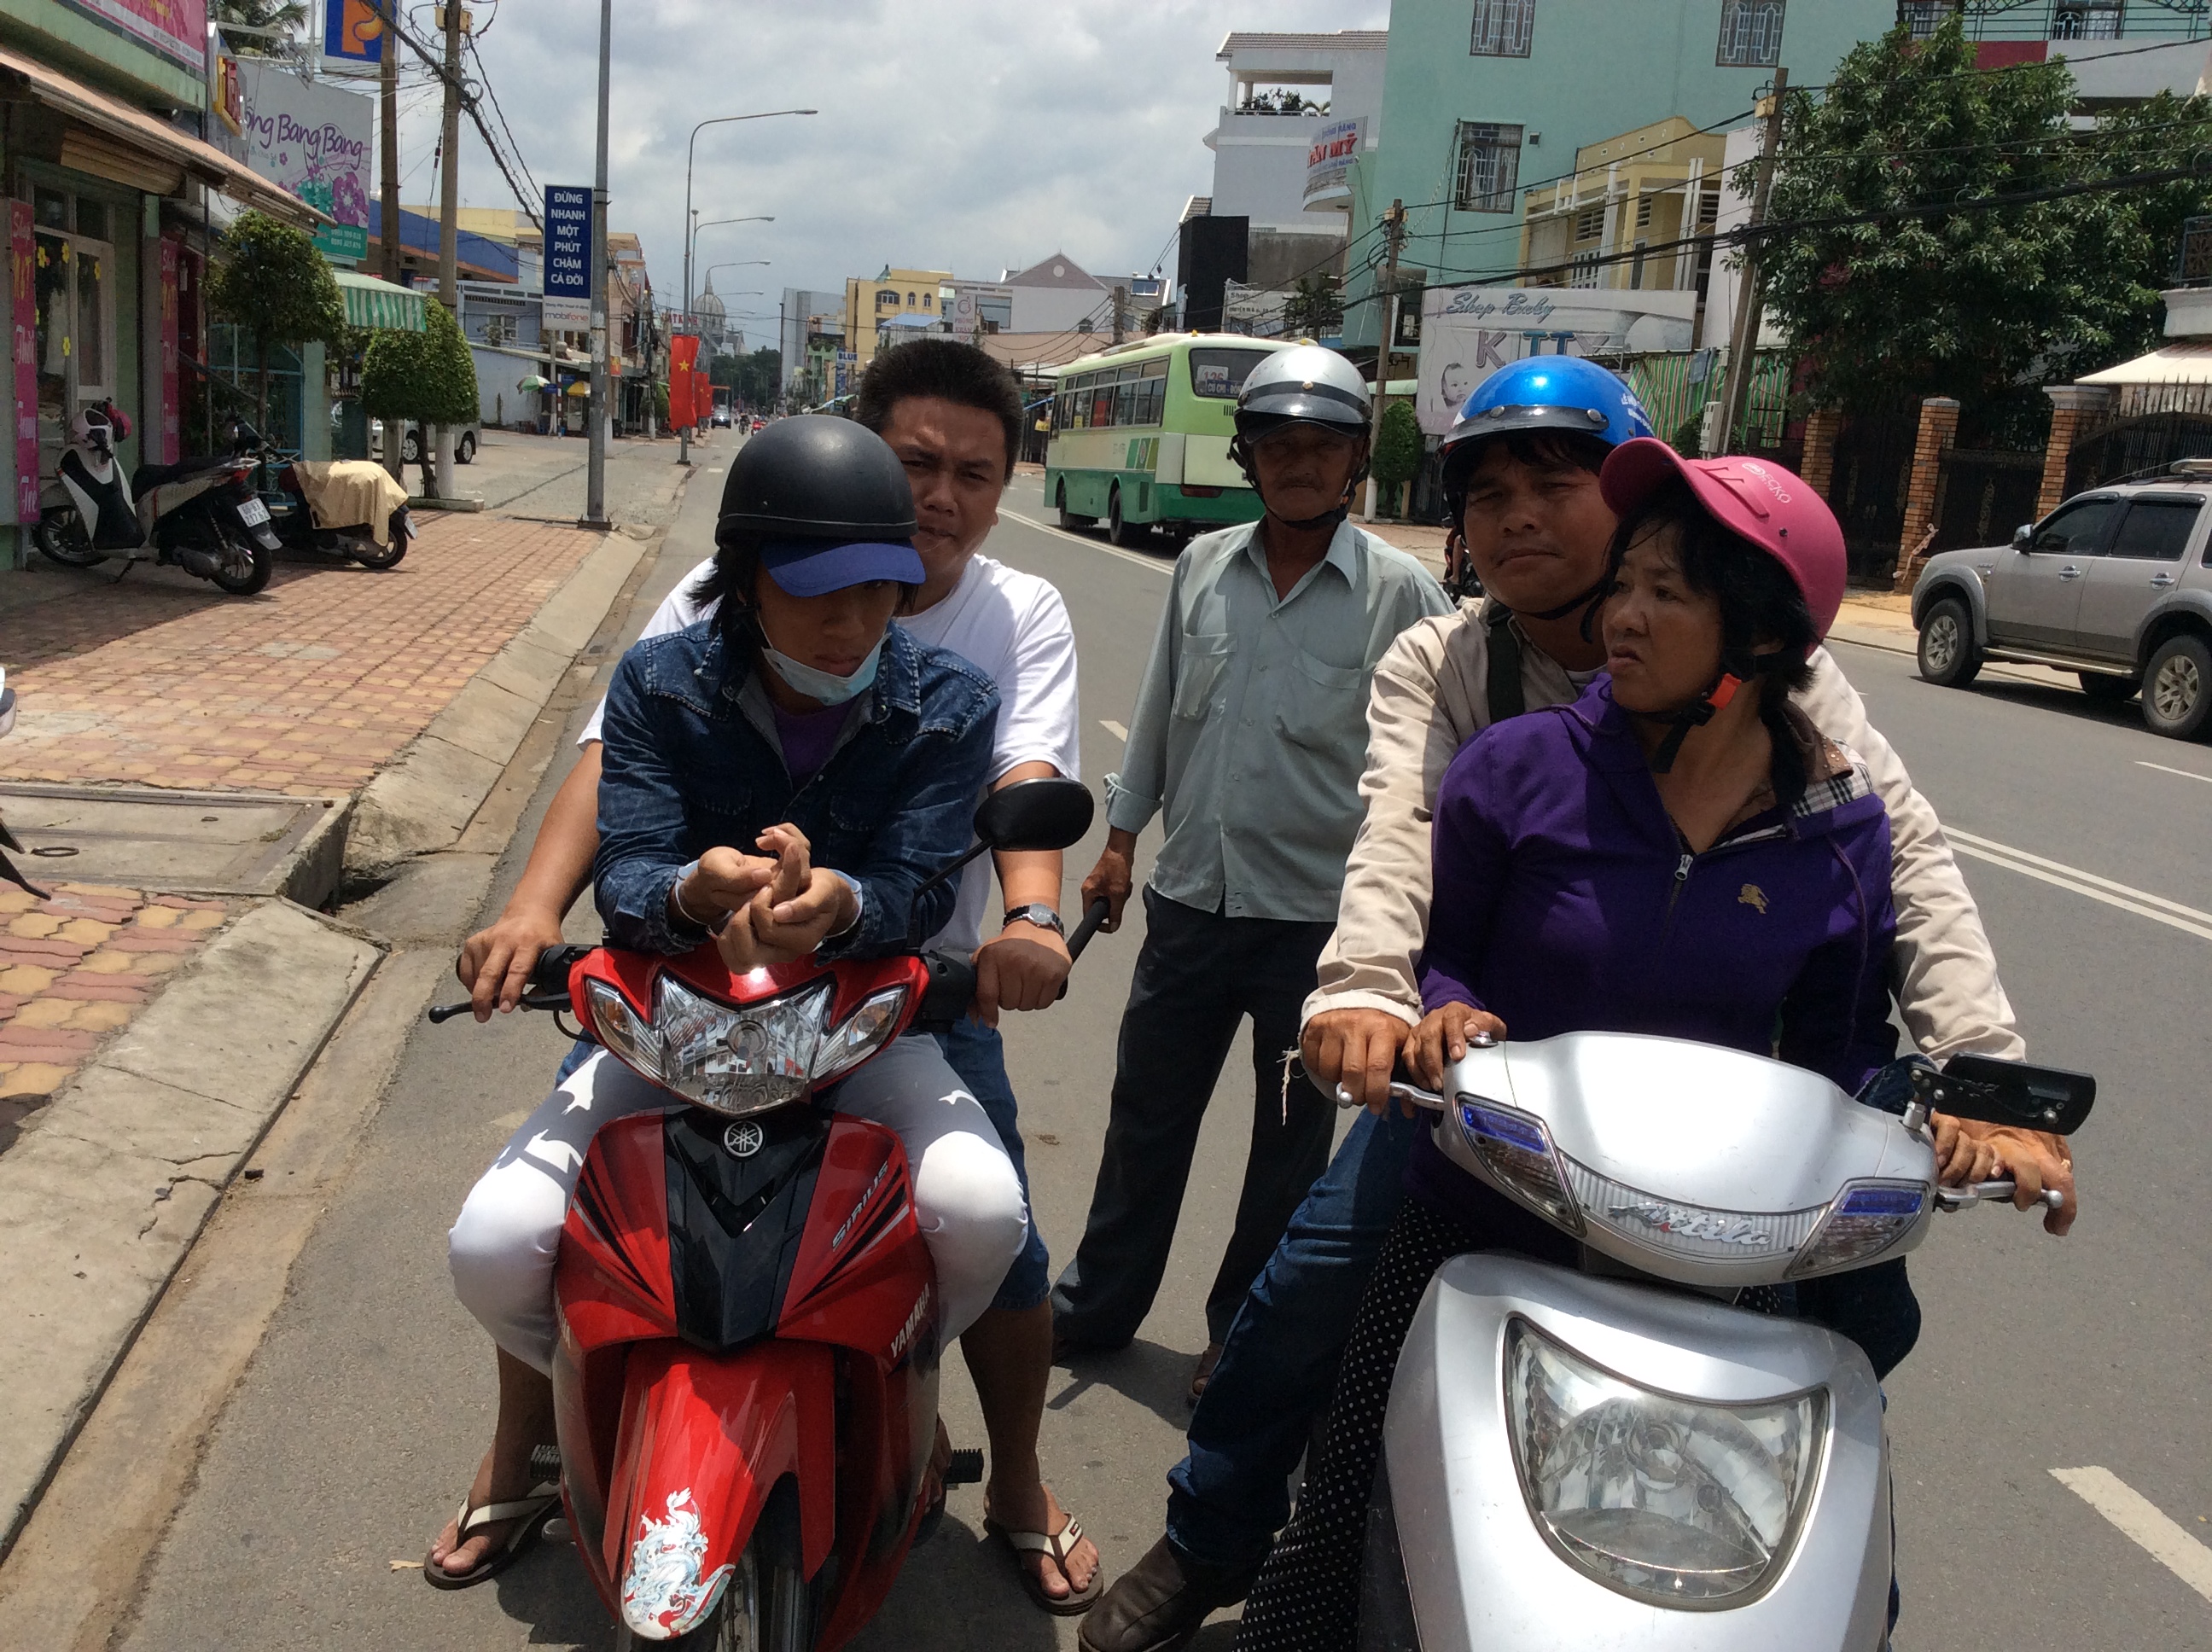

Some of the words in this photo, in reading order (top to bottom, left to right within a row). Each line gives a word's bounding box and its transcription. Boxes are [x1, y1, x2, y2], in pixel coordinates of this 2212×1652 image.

[277, 113, 320, 160] Bang
[323, 126, 364, 171] Bang
[1329, 132, 1358, 158] MỸ
[554, 190, 584, 205] ĐỪNG
[550, 208, 586, 220] NHANH
[556, 224, 580, 238] MỘT
[554, 241, 582, 253] PHÚT
[553, 256, 582, 271] CHẬM
[550, 271, 565, 284] CẢ
[565, 273, 584, 286] ĐỜI
[1446, 292, 1495, 320] Shop
[1501, 292, 1556, 323] Baby
[544, 311, 589, 322] mobifone
[838, 352, 858, 362] BLUE
[1761, 474, 1792, 503] ECKO
[832, 1160, 888, 1252] SIRIUS
[1608, 1200, 1774, 1246] Attila
[890, 1282, 931, 1359] YAMAHA
